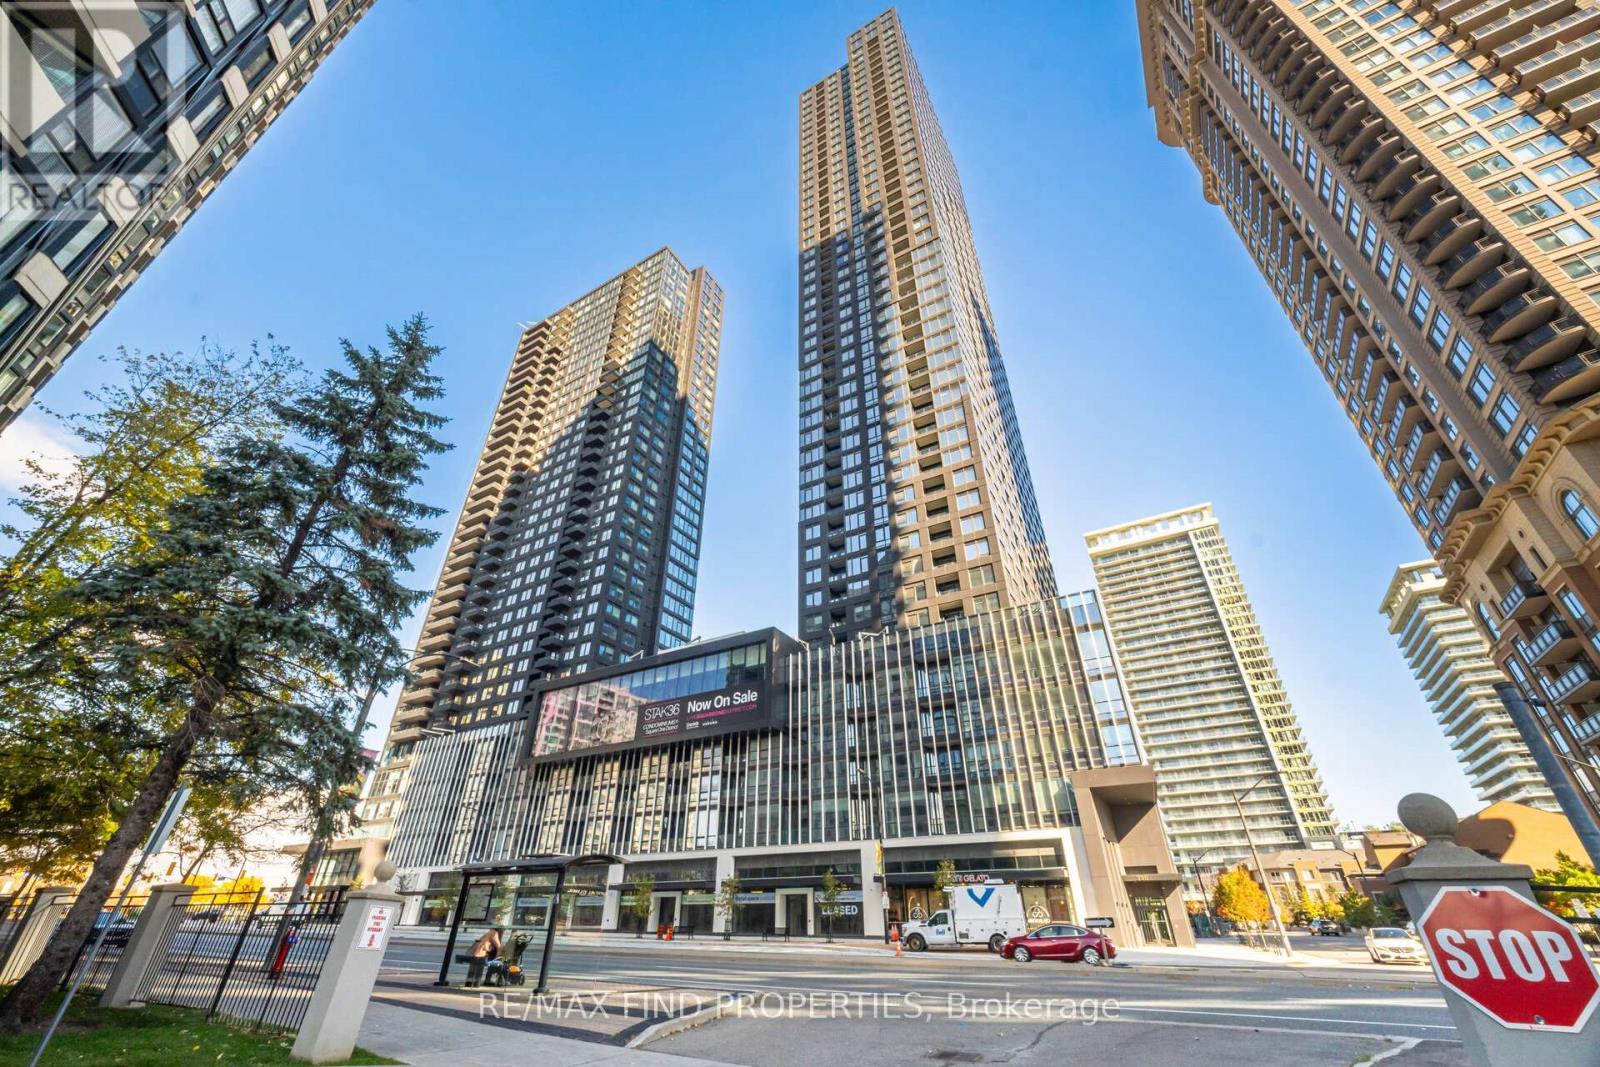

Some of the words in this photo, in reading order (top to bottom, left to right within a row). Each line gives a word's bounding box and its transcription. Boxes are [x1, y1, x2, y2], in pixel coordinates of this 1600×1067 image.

[644, 703, 680, 721] STAK36
[687, 700, 712, 713] Now
[714, 695, 730, 708] On
[733, 690, 758, 705] Sale
[1435, 928, 1573, 983] STOP
